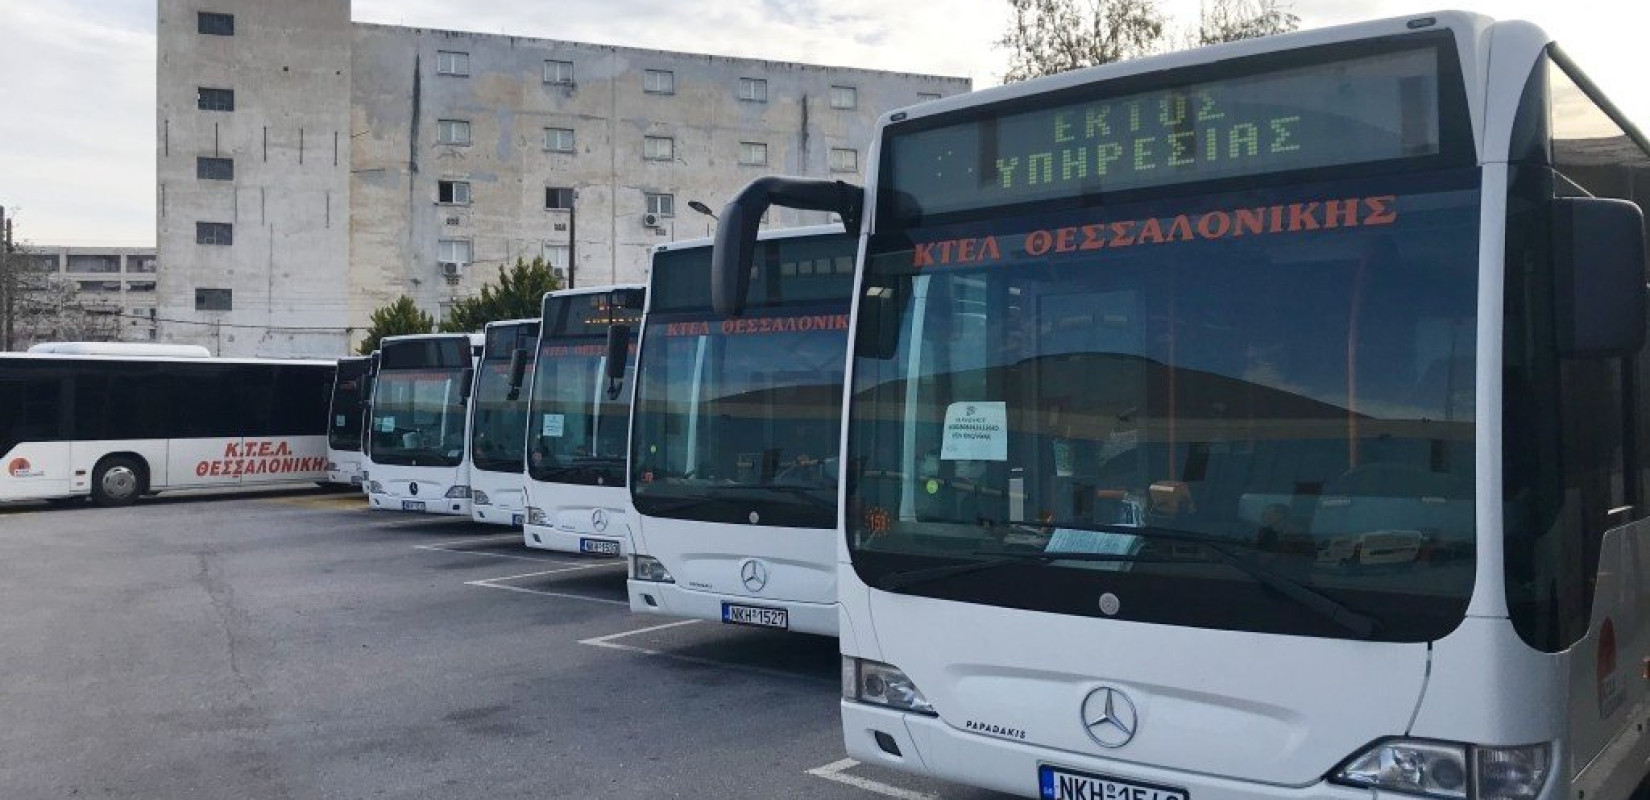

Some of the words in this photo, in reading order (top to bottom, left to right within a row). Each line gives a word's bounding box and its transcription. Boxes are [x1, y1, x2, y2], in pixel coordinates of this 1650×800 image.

[1054, 88, 1226, 144] ΕΚΤΟΣ
[995, 115, 1301, 189] ΥΠΗΡΕΣΙΑΣ
[913, 234, 1000, 267] ΚΤΕΛ
[1024, 194, 1398, 257] ΘΕΣΣΑΛΟΝΙΚΗΣ
[667, 322, 709, 336] ΚΤΕΛ
[224, 441, 293, 457] Κ.Τ.Ε.Λ.
[966, 720, 1026, 739] PAPADAKIS
